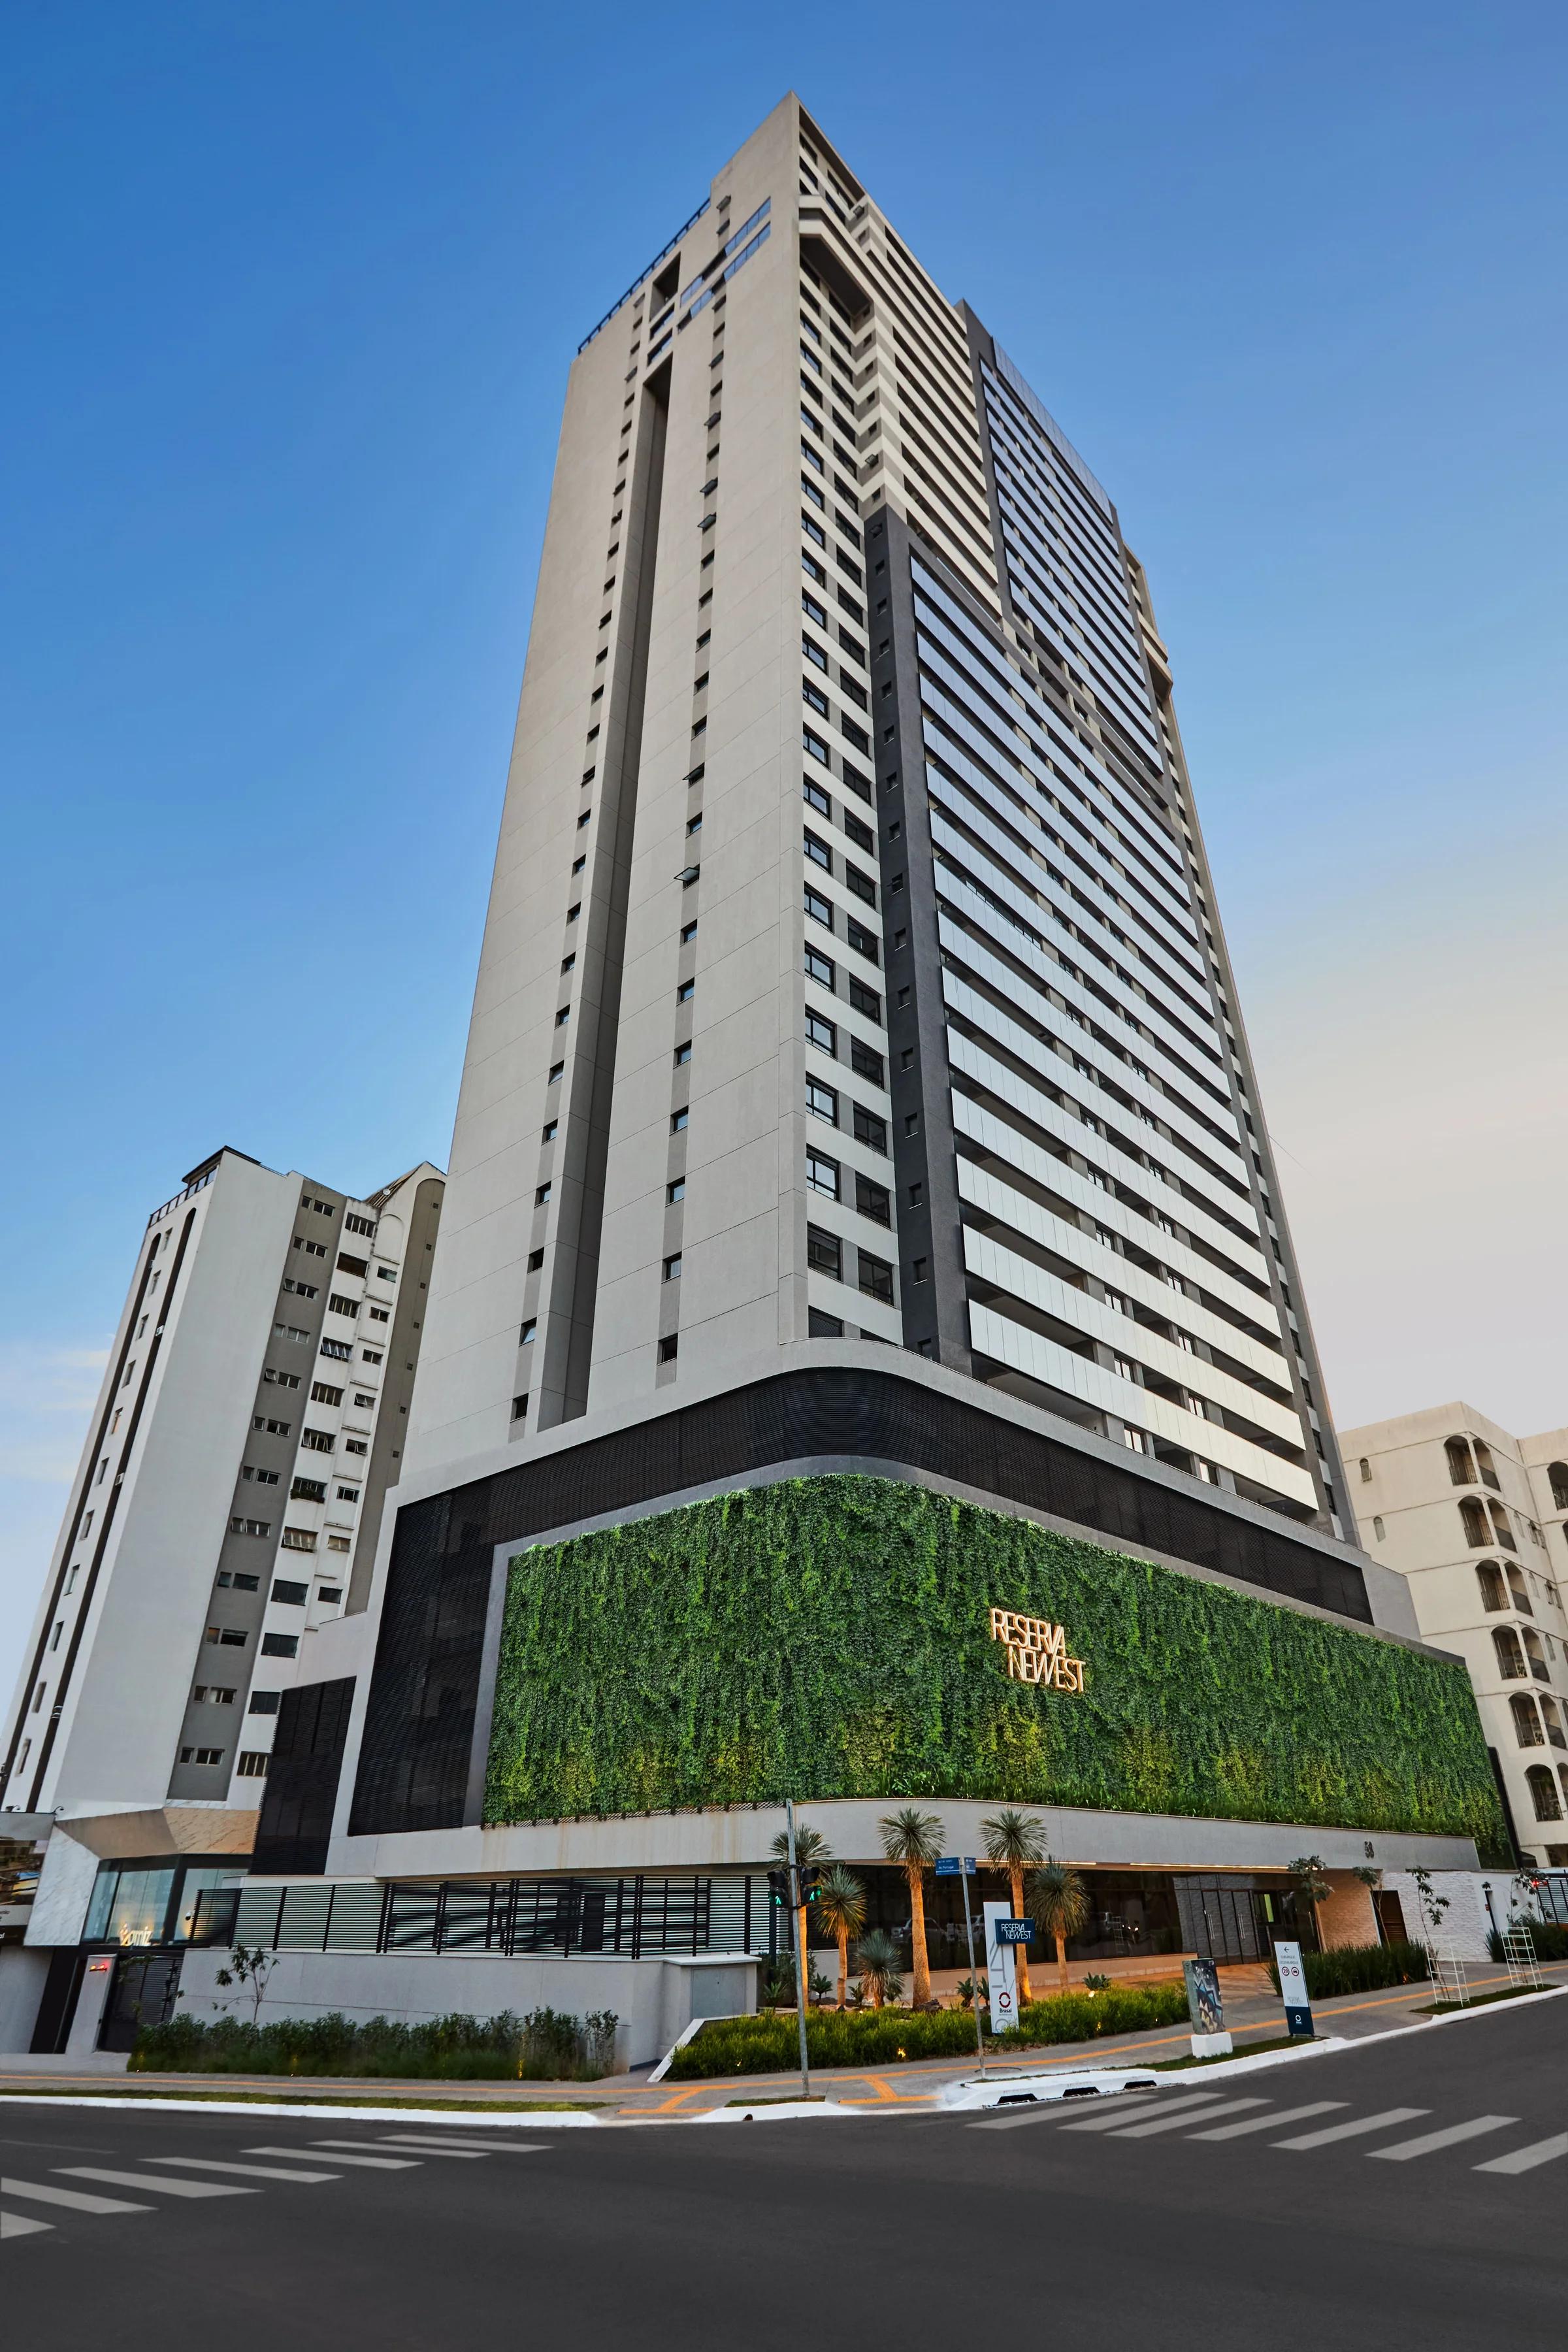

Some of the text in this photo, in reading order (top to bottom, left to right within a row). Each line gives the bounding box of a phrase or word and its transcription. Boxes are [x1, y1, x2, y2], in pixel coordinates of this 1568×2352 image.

[990, 1607, 1066, 1657] RESERVA
[1007, 1645, 1086, 1693] NEWEST
[1001, 1923, 1025, 1932] RESERVA
[1005, 1931, 1032, 1940] NEWEST
